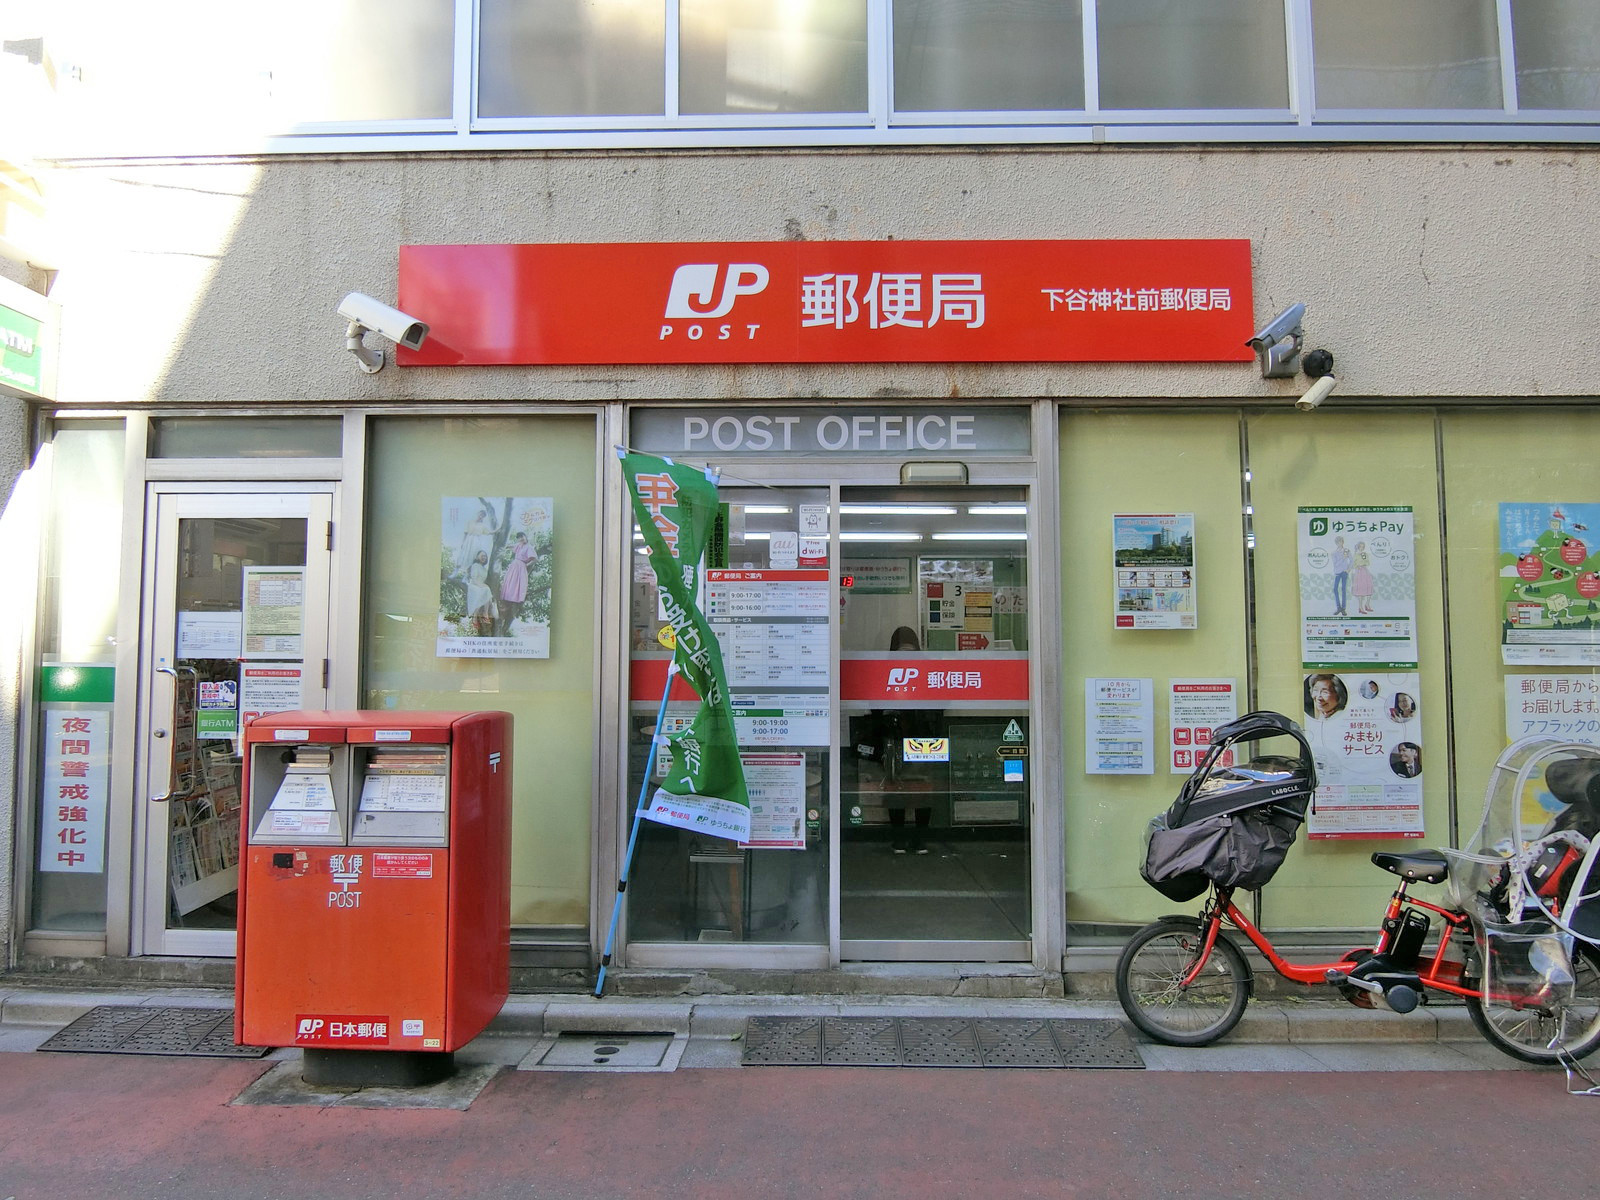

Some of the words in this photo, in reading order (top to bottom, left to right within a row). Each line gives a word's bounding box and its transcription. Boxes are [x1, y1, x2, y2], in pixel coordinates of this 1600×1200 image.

[664, 264, 770, 319] JP
[1040, 287, 1232, 312] 下谷神社前郵便局
[801, 272, 985, 330] 郵便局
[660, 324, 761, 341] POST
[684, 415, 801, 451] POST
[816, 415, 978, 451] OFFICE
[1332, 520, 1404, 535] ゆうちょPay
[843, 576, 854, 587] 13
[954, 585, 962, 597] 3
[887, 668, 919, 686] JP
[927, 671, 982, 689] 郵便局
[1521, 679, 1599, 694] 郵便局から
[1521, 699, 1600, 714] お届けします。
[1522, 719, 1600, 733] アフラックの
[1343, 730, 1383, 743] みまもり
[1343, 743, 1385, 756] サービス
[57, 717, 92, 867] 夜間警戒強化中
[710, 819, 746, 834] ゆうちょ銀行
[329, 854, 364, 874] 郵便
[328, 891, 362, 908] POST
[329, 1022, 387, 1038] 日本郵便
